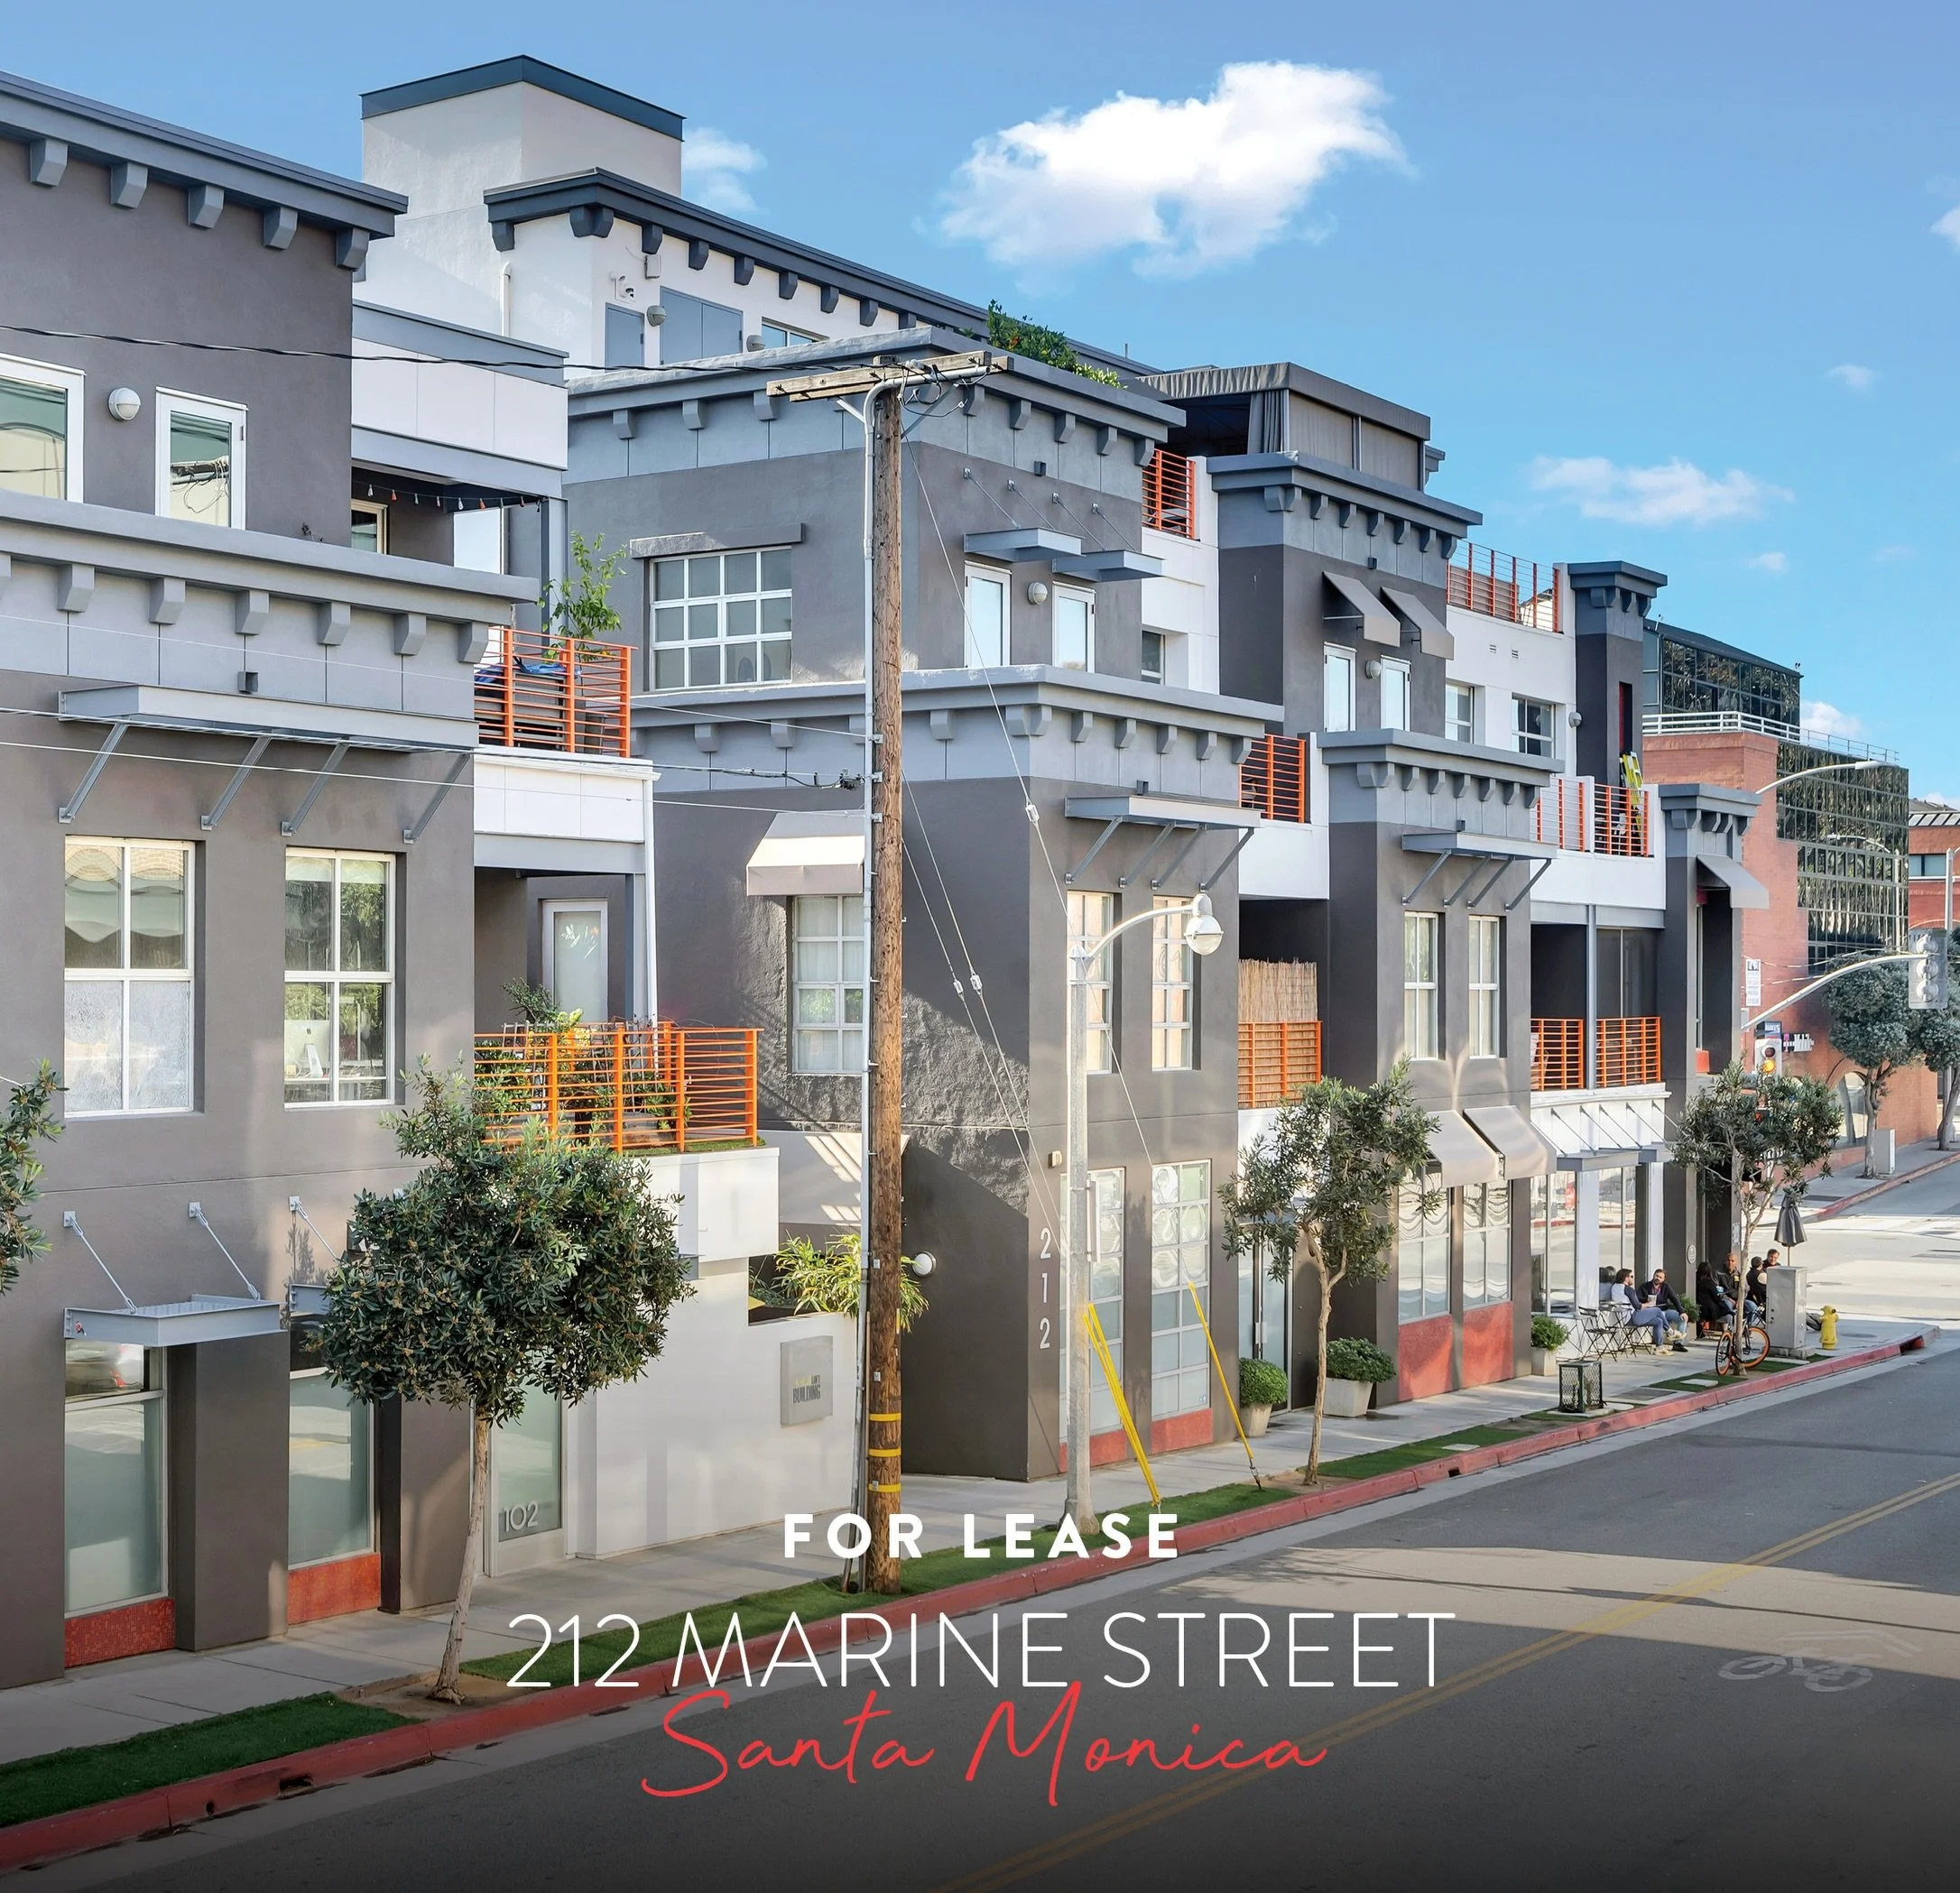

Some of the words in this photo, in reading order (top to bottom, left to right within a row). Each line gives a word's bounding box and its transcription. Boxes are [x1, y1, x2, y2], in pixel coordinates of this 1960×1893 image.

[1040, 1227, 1051, 1350] 212
[792, 1384, 821, 1404] BUILDING
[504, 1501, 539, 1532] 102
